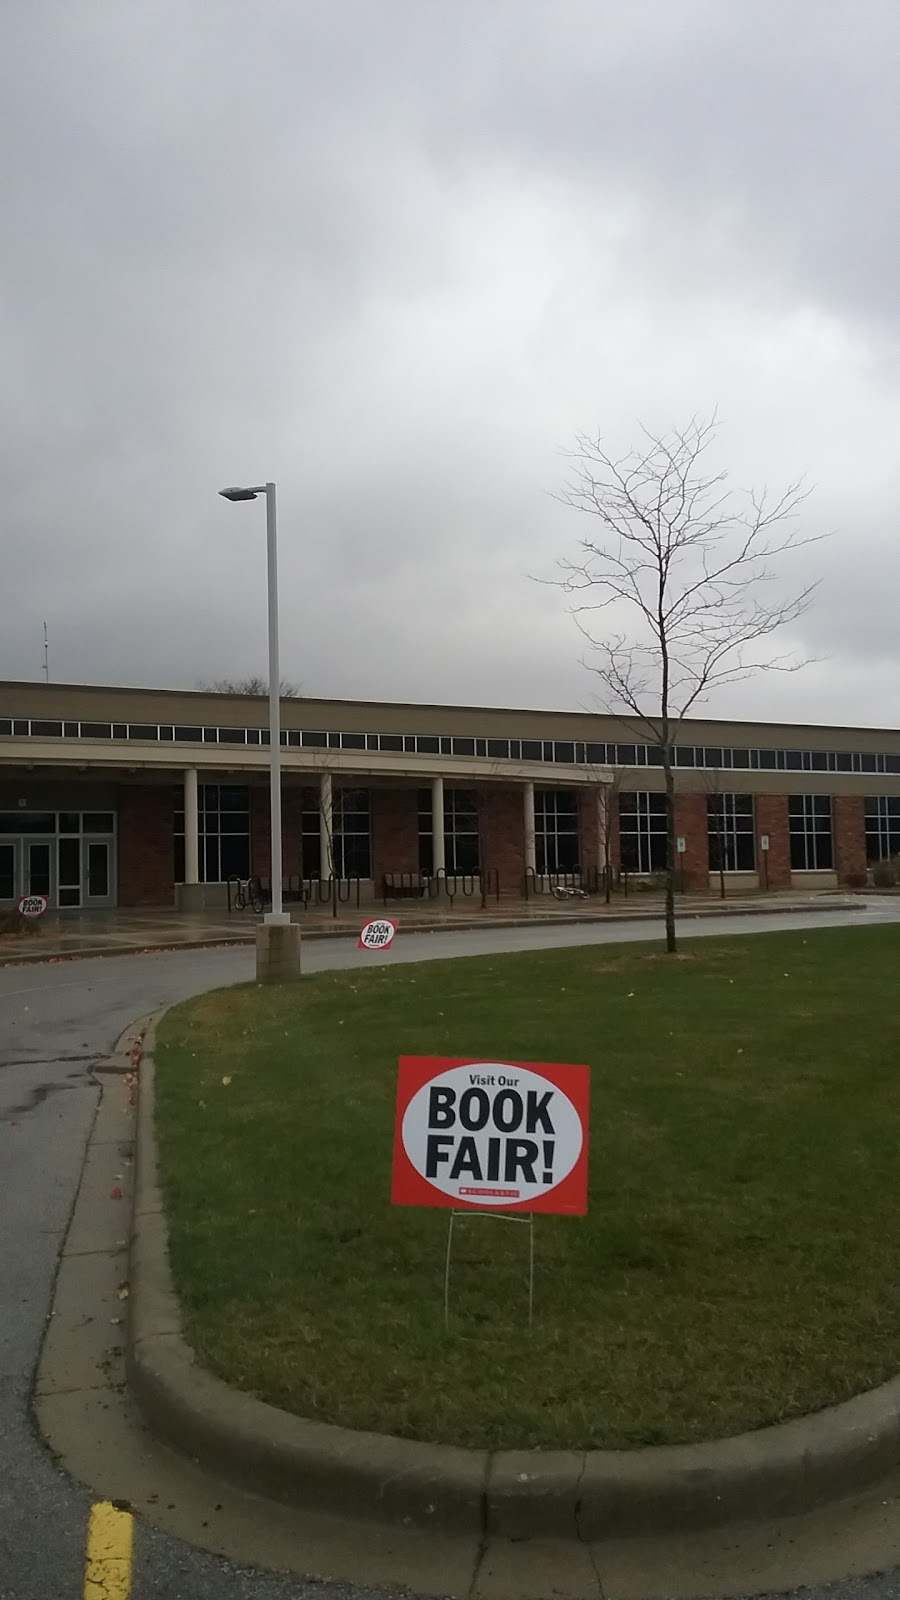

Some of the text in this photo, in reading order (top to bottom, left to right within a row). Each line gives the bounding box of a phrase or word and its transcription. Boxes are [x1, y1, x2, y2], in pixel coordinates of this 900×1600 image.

[367, 924, 390, 934] BOOK
[364, 934, 389, 944] FAIR!
[469, 1074, 519, 1087] Visit Our
[428, 1086, 556, 1135] BOOK
[425, 1134, 555, 1184] FAIR!
